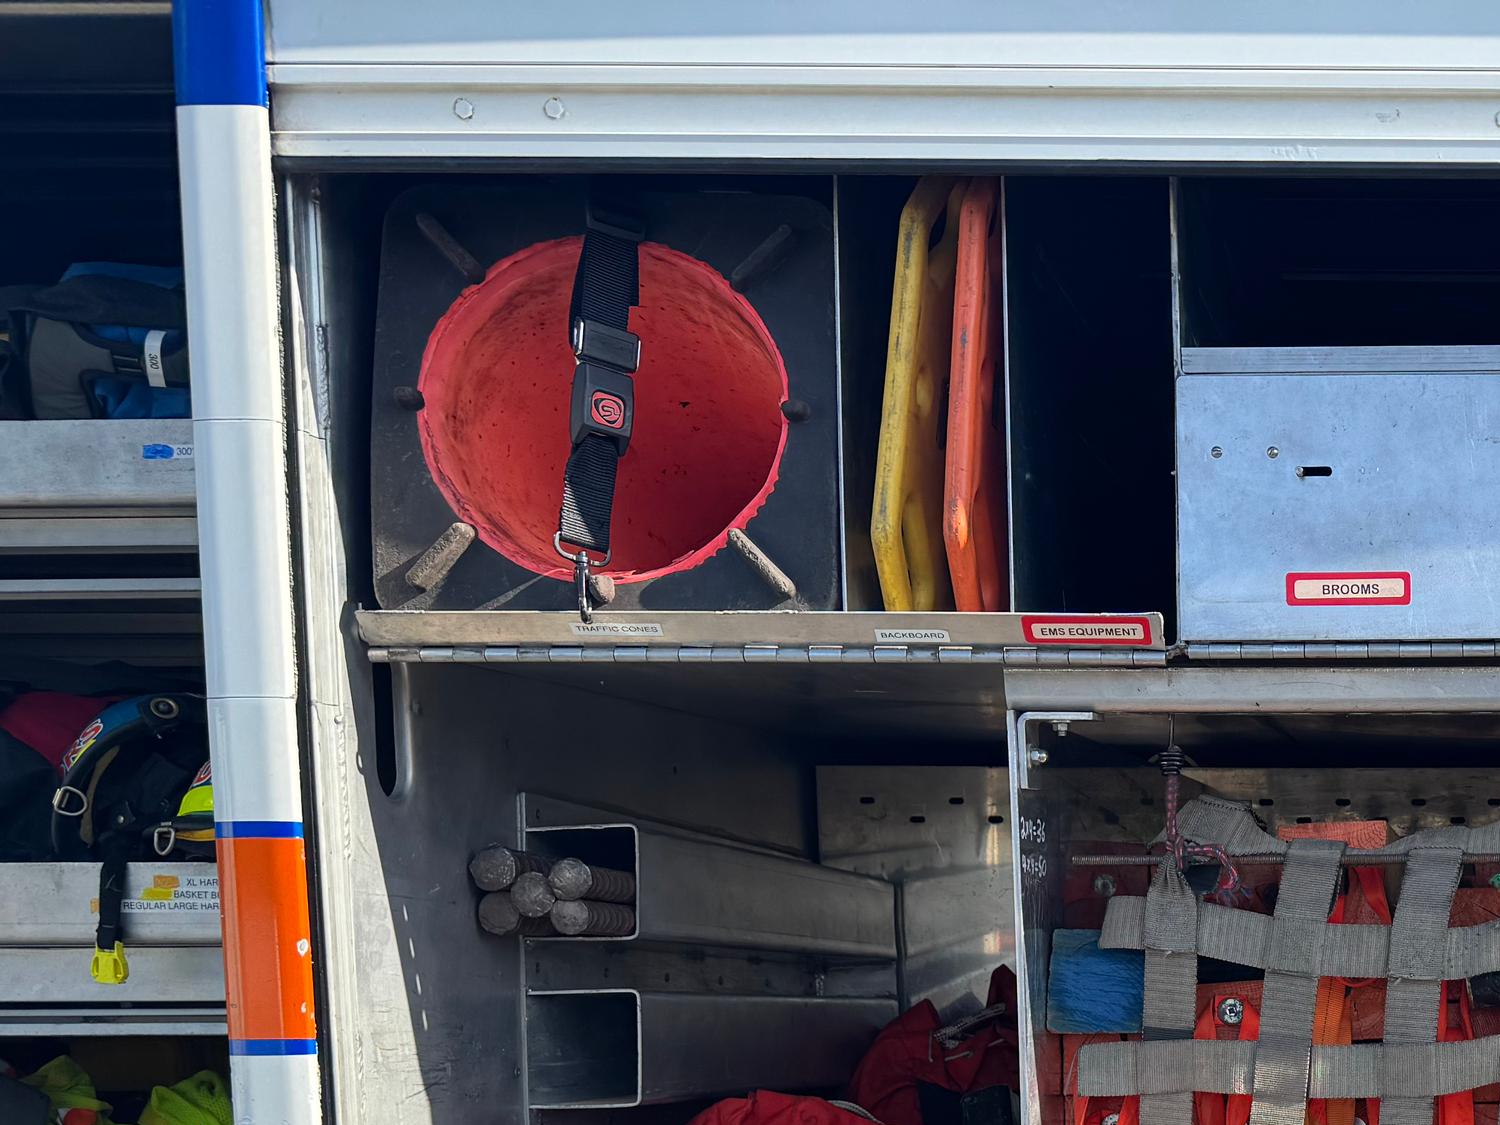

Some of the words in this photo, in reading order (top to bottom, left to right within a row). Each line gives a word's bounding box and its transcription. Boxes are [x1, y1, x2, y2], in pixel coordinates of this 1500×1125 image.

[149, 353, 160, 370] 300
[1322, 584, 1380, 595] BROOMS
[576, 625, 619, 633] TRAFFIC
[621, 625, 658, 633] CONES
[1040, 627, 1065, 637] EMS
[1068, 627, 1138, 637] EQUIPMENT
[880, 631, 945, 640] BACKBOARD
[186, 878, 197, 886] XL
[174, 890, 208, 899] BASKET
[123, 901, 166, 910] REGULAR
[168, 901, 198, 910] LARGE
